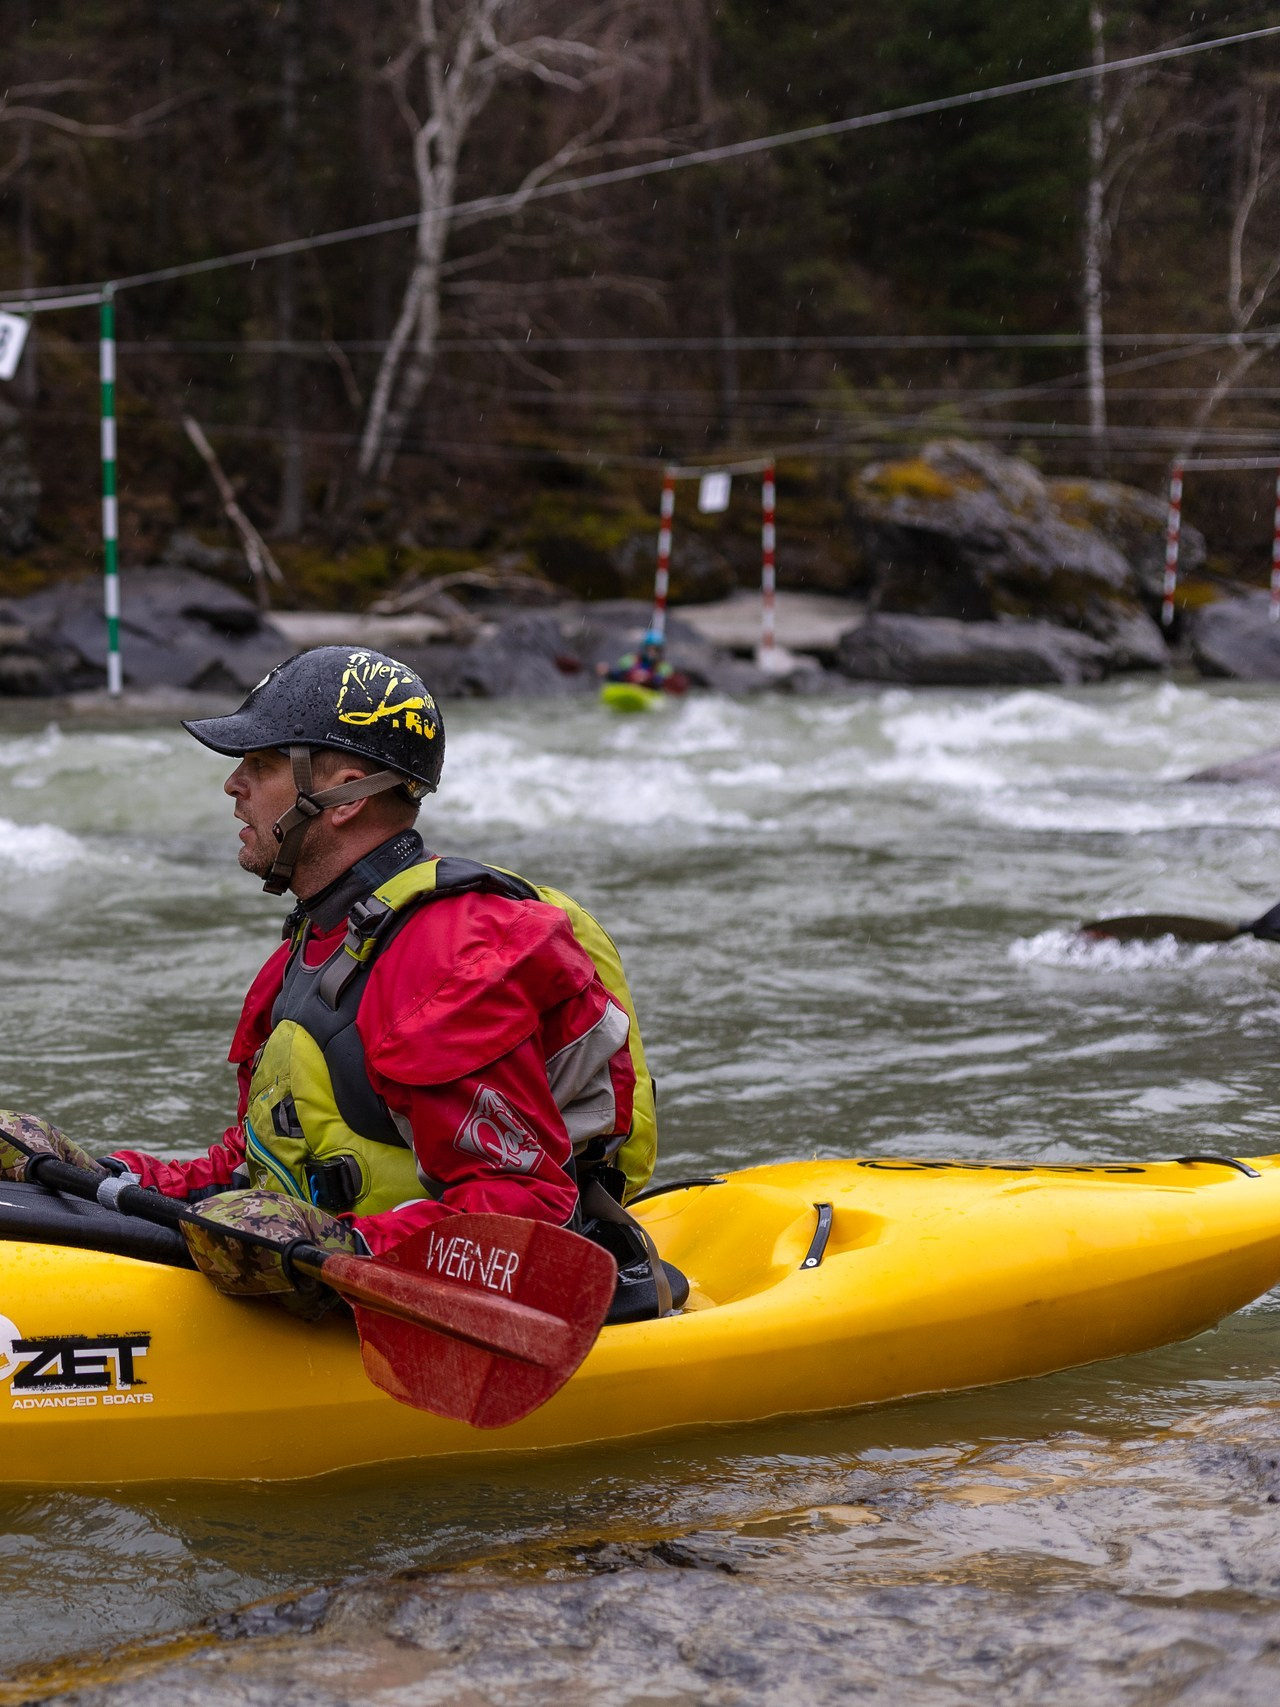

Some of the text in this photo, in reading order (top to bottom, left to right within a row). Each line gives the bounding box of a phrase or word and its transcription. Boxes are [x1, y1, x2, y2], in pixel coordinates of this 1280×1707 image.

[427, 1230, 520, 1294] WERNER
[10, 1331, 152, 1396] ZET
[12, 1393, 154, 1410] ADVANCED BOATS
